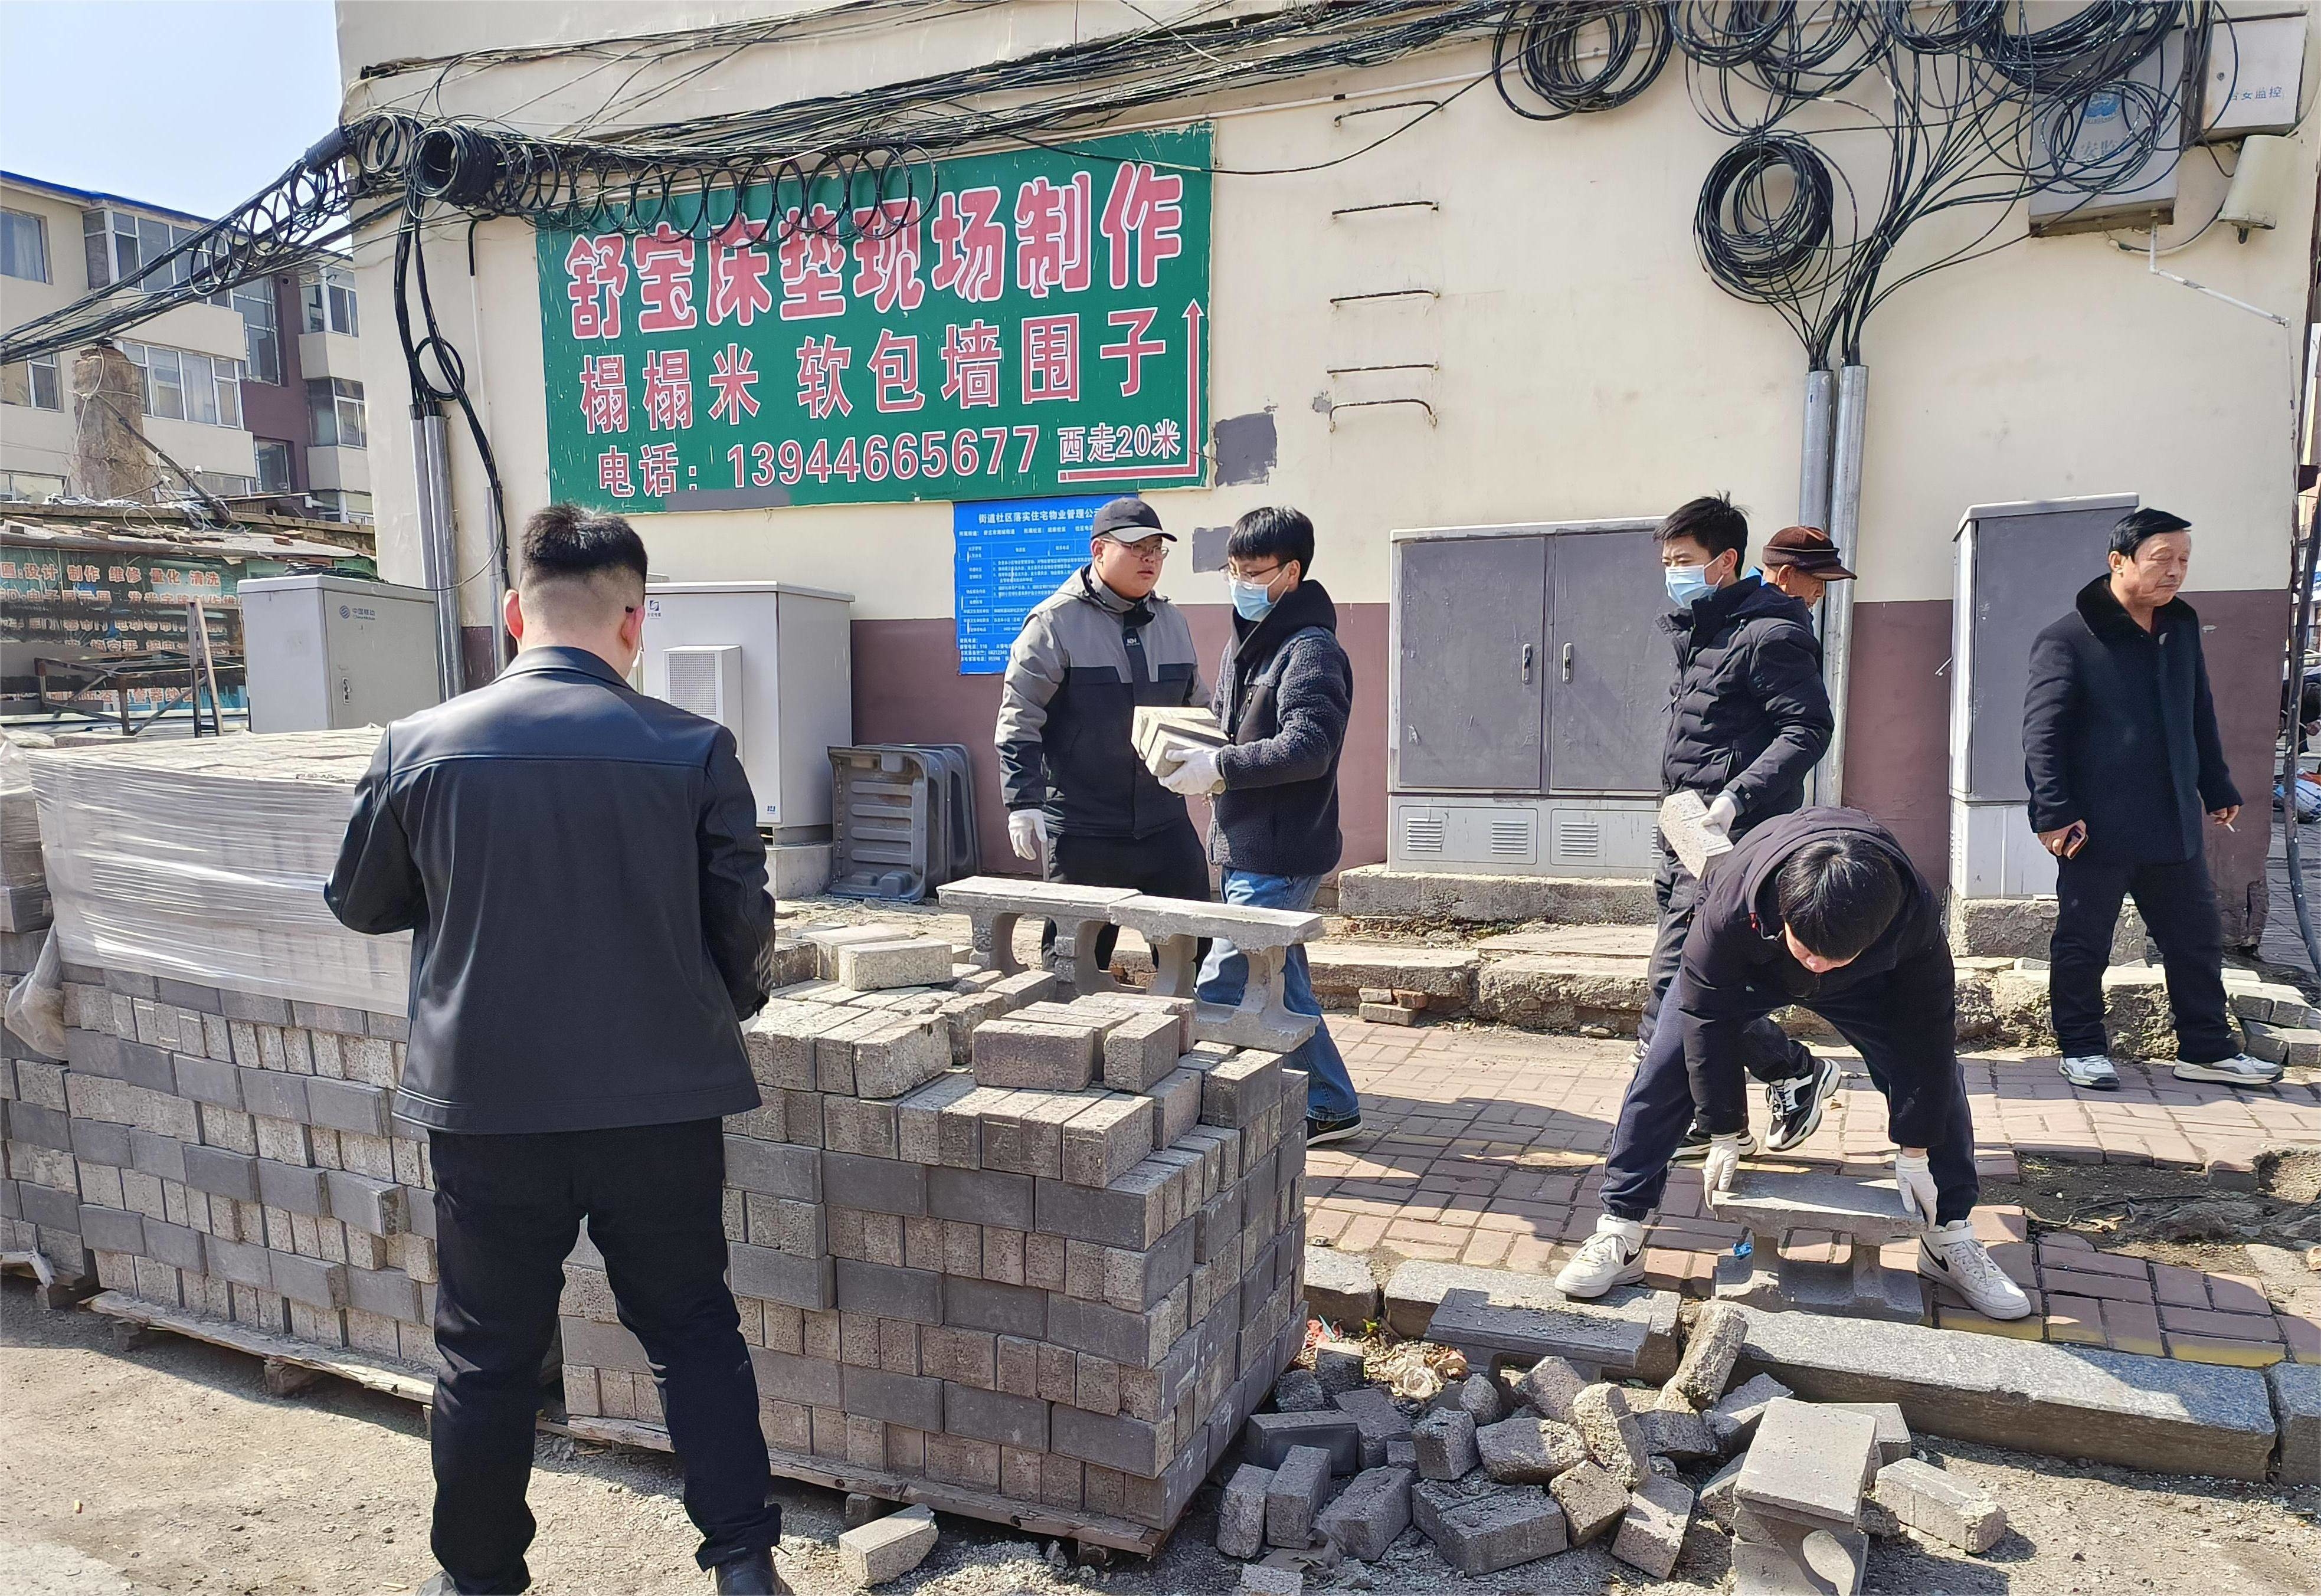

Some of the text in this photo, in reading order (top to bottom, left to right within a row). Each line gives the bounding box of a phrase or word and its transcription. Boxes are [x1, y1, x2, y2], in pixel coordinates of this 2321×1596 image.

[564, 160, 1182, 340] 舒宝床垫现场制作
[580, 306, 1167, 434] 榻榻米 软包墙围子
[726, 424, 1039, 489] 13944665677
[1058, 418, 1181, 464] 西走20米
[67, 565, 100, 582] 制作
[109, 566, 142, 583] 维修
